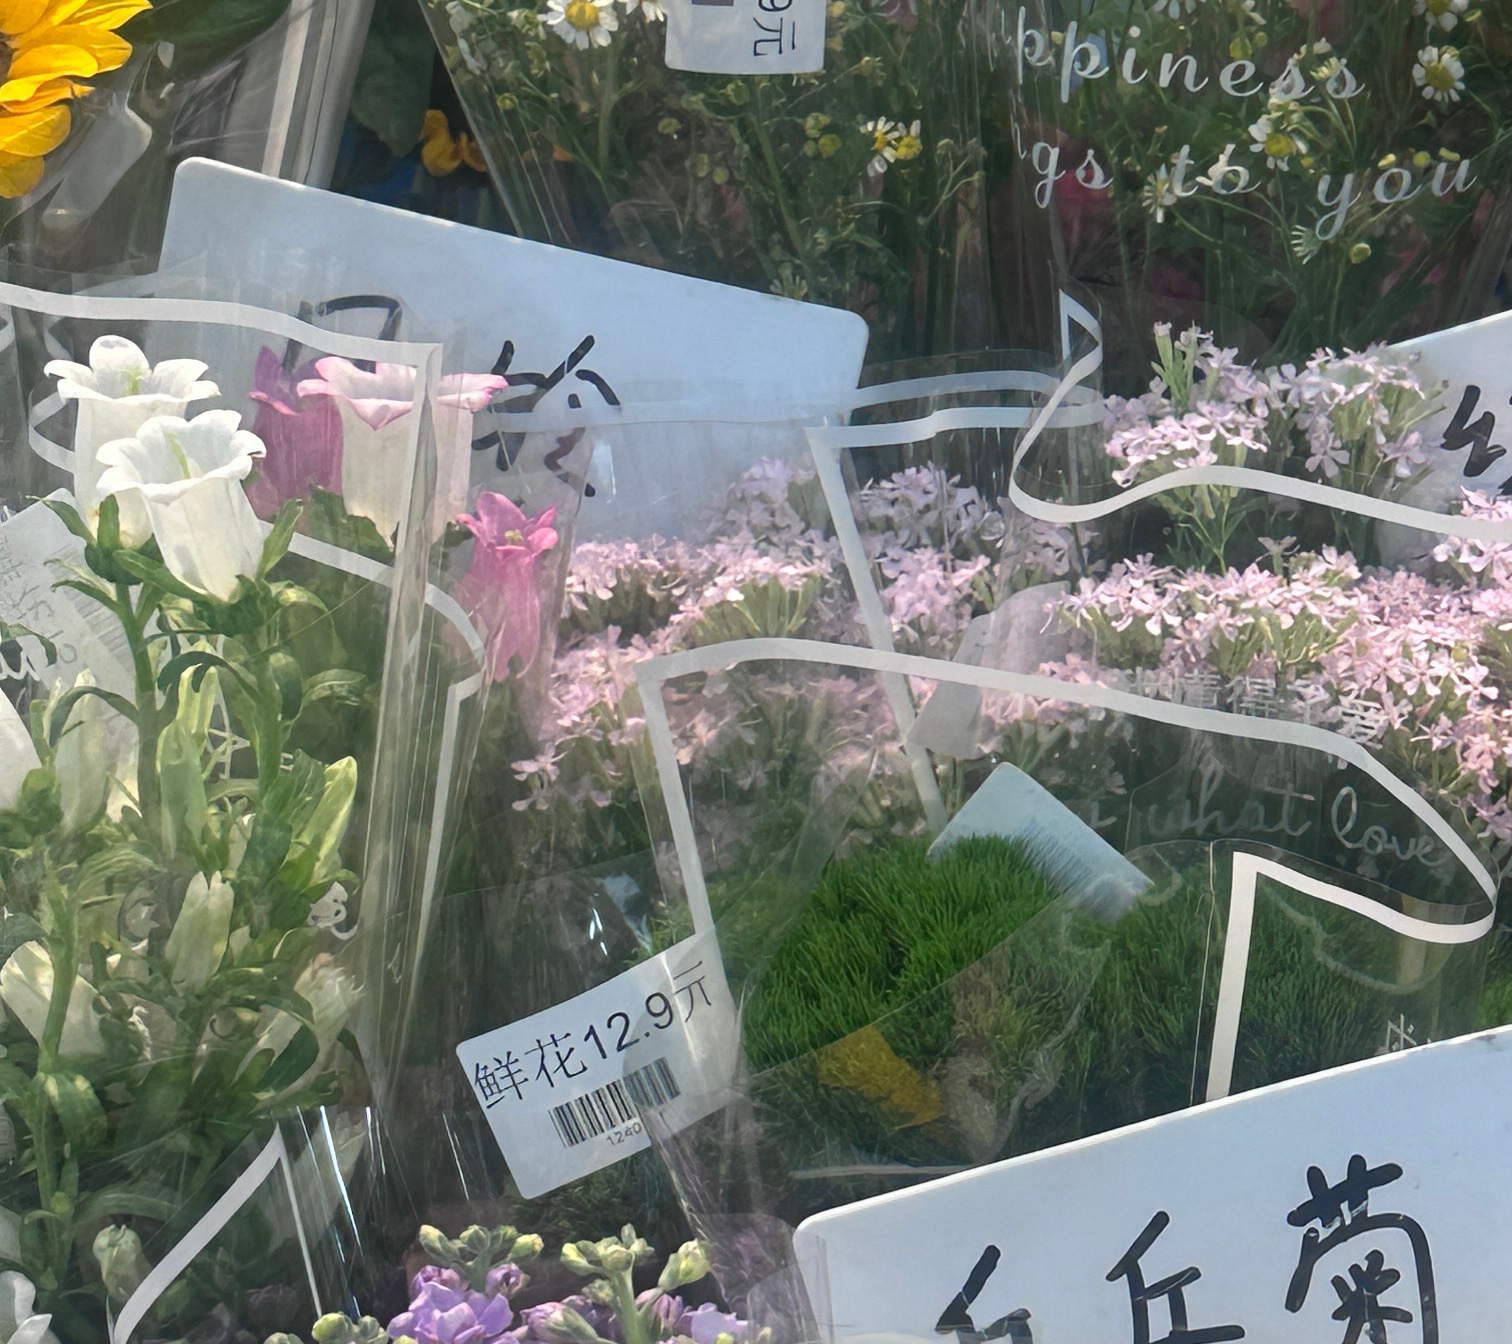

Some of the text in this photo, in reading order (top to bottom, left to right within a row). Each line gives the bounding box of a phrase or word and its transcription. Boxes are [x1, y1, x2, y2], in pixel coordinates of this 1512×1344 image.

[1315, 152, 1477, 243] you
[473, 959, 712, 1110] 鲜花12.9元
